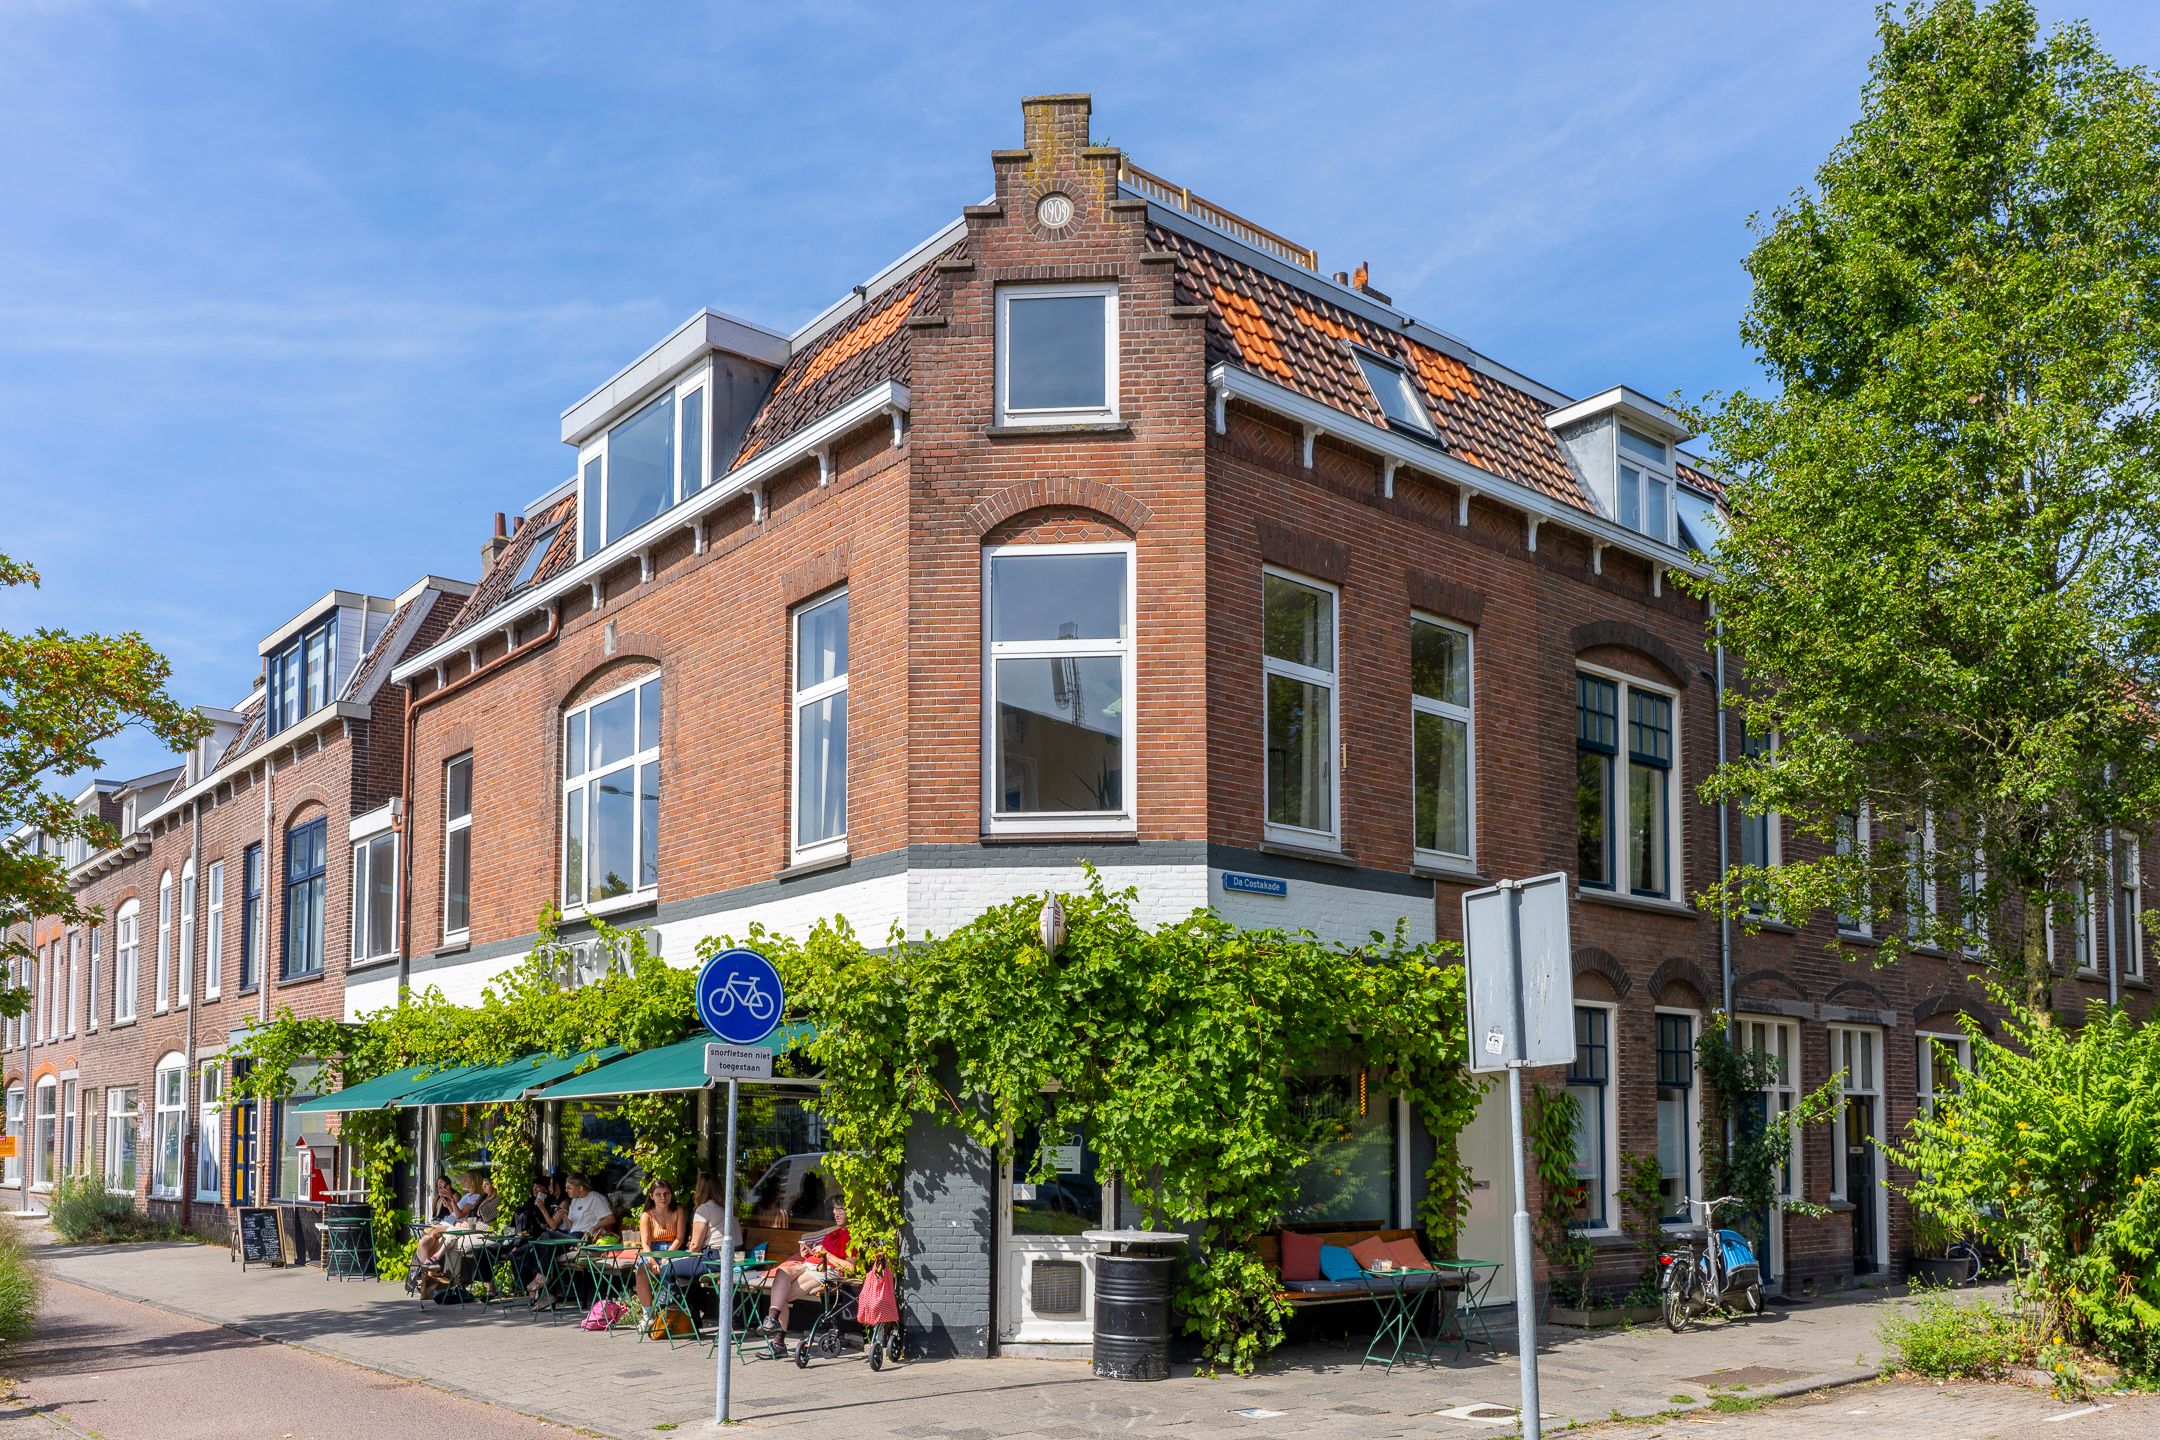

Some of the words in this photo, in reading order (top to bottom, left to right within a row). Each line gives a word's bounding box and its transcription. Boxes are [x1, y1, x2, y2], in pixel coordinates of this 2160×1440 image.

[1043, 200, 1067, 222] 1909
[1233, 876, 1243, 887] Da
[1244, 878, 1280, 891] Costakade
[710, 1048, 753, 1059] snorfietsen
[755, 1051, 771, 1060] niet
[719, 1062, 761, 1072] toegestaan
